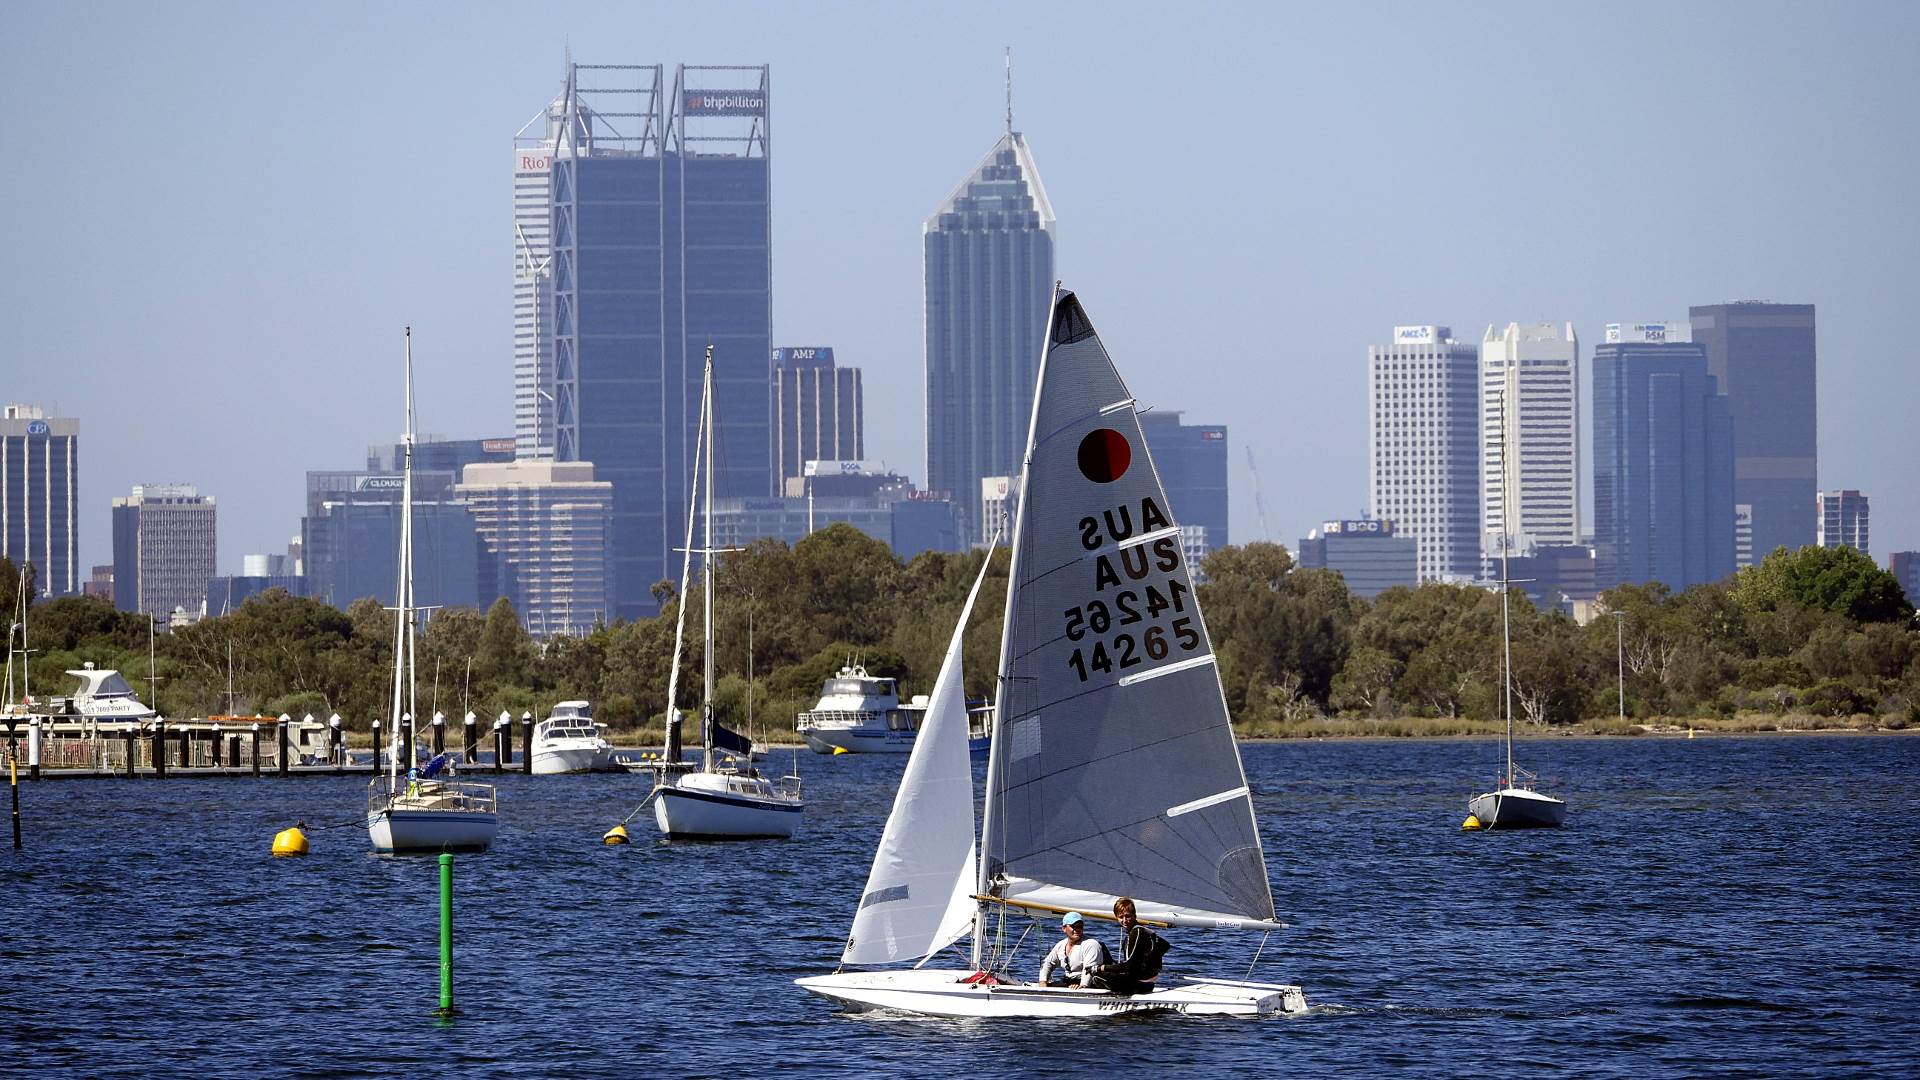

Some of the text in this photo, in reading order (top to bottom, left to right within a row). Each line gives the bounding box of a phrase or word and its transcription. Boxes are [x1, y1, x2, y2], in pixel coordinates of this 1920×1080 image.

[703, 95, 764, 110] bhpbilliton
[791, 349, 816, 359] AMP
[1096, 537, 1179, 592] AUS
[1068, 617, 1200, 683] 14265
[1098, 1000, 1188, 1013] WHITE SHARK
